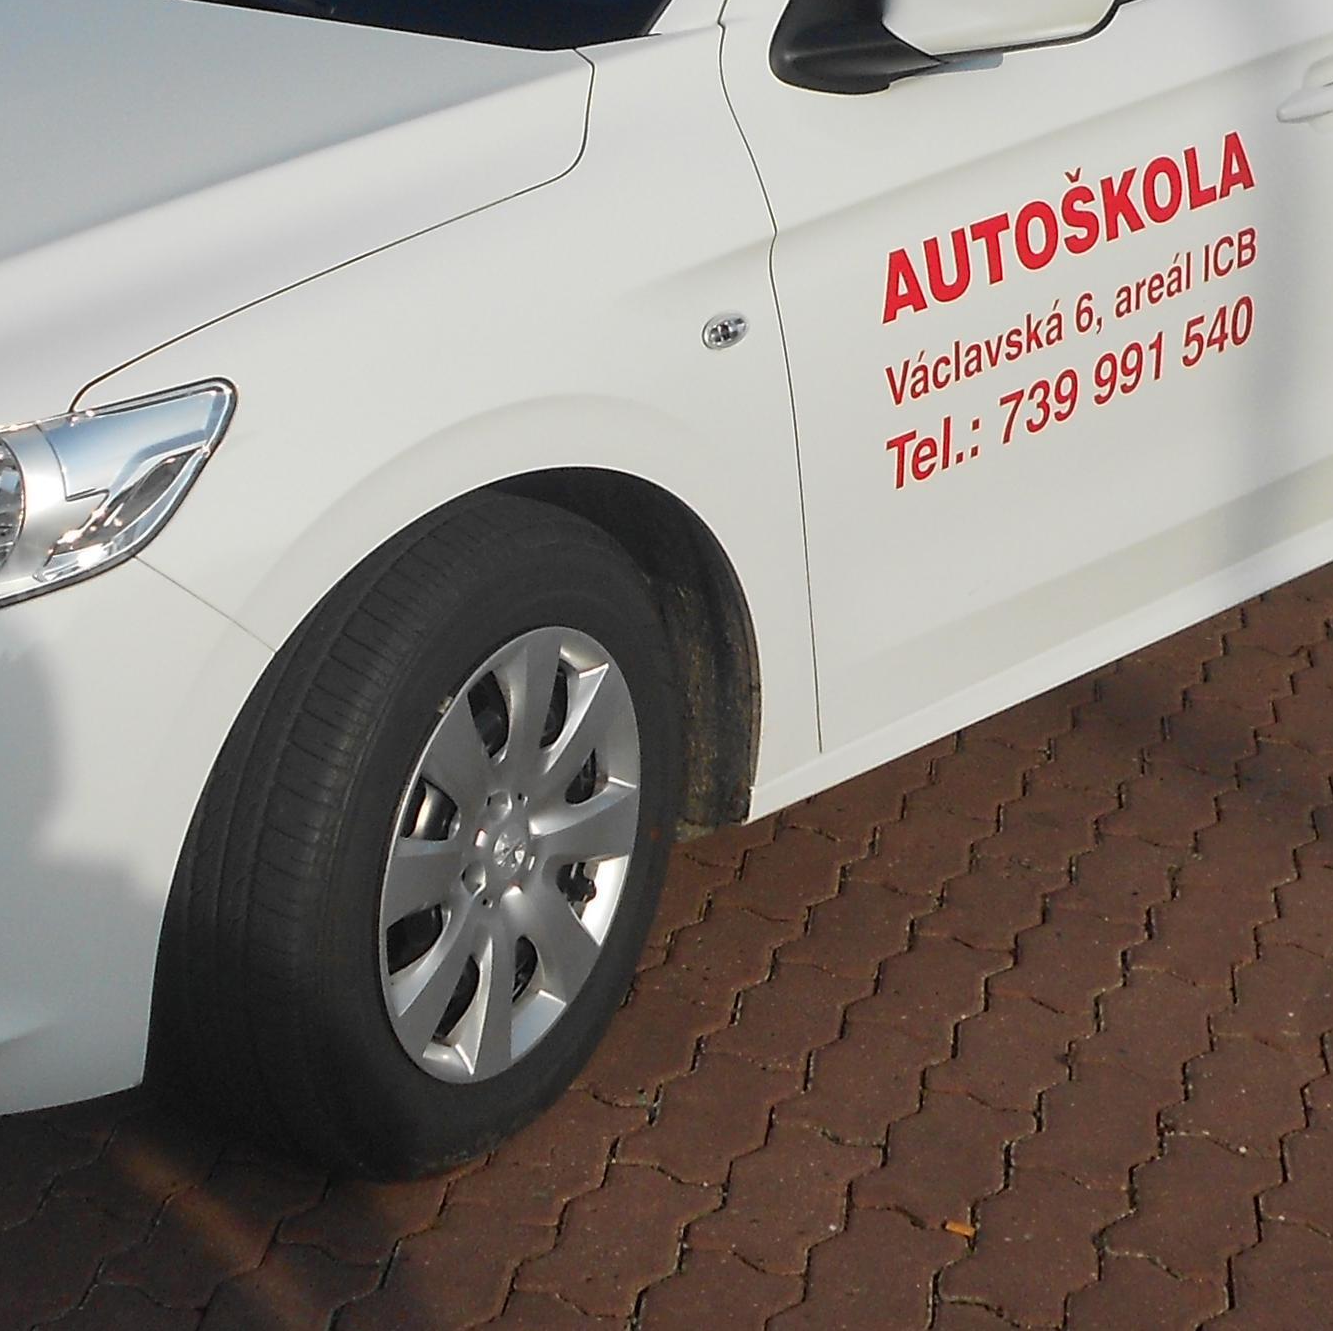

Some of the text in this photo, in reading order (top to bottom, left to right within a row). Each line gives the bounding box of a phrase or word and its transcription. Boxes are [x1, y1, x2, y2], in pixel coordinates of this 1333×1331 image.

[882, 130, 1257, 325] AUTOŠKOLA
[885, 227, 1259, 406] Václavská 6, areál ICB
[885, 295, 1255, 490] Tel.: 739 991 540
